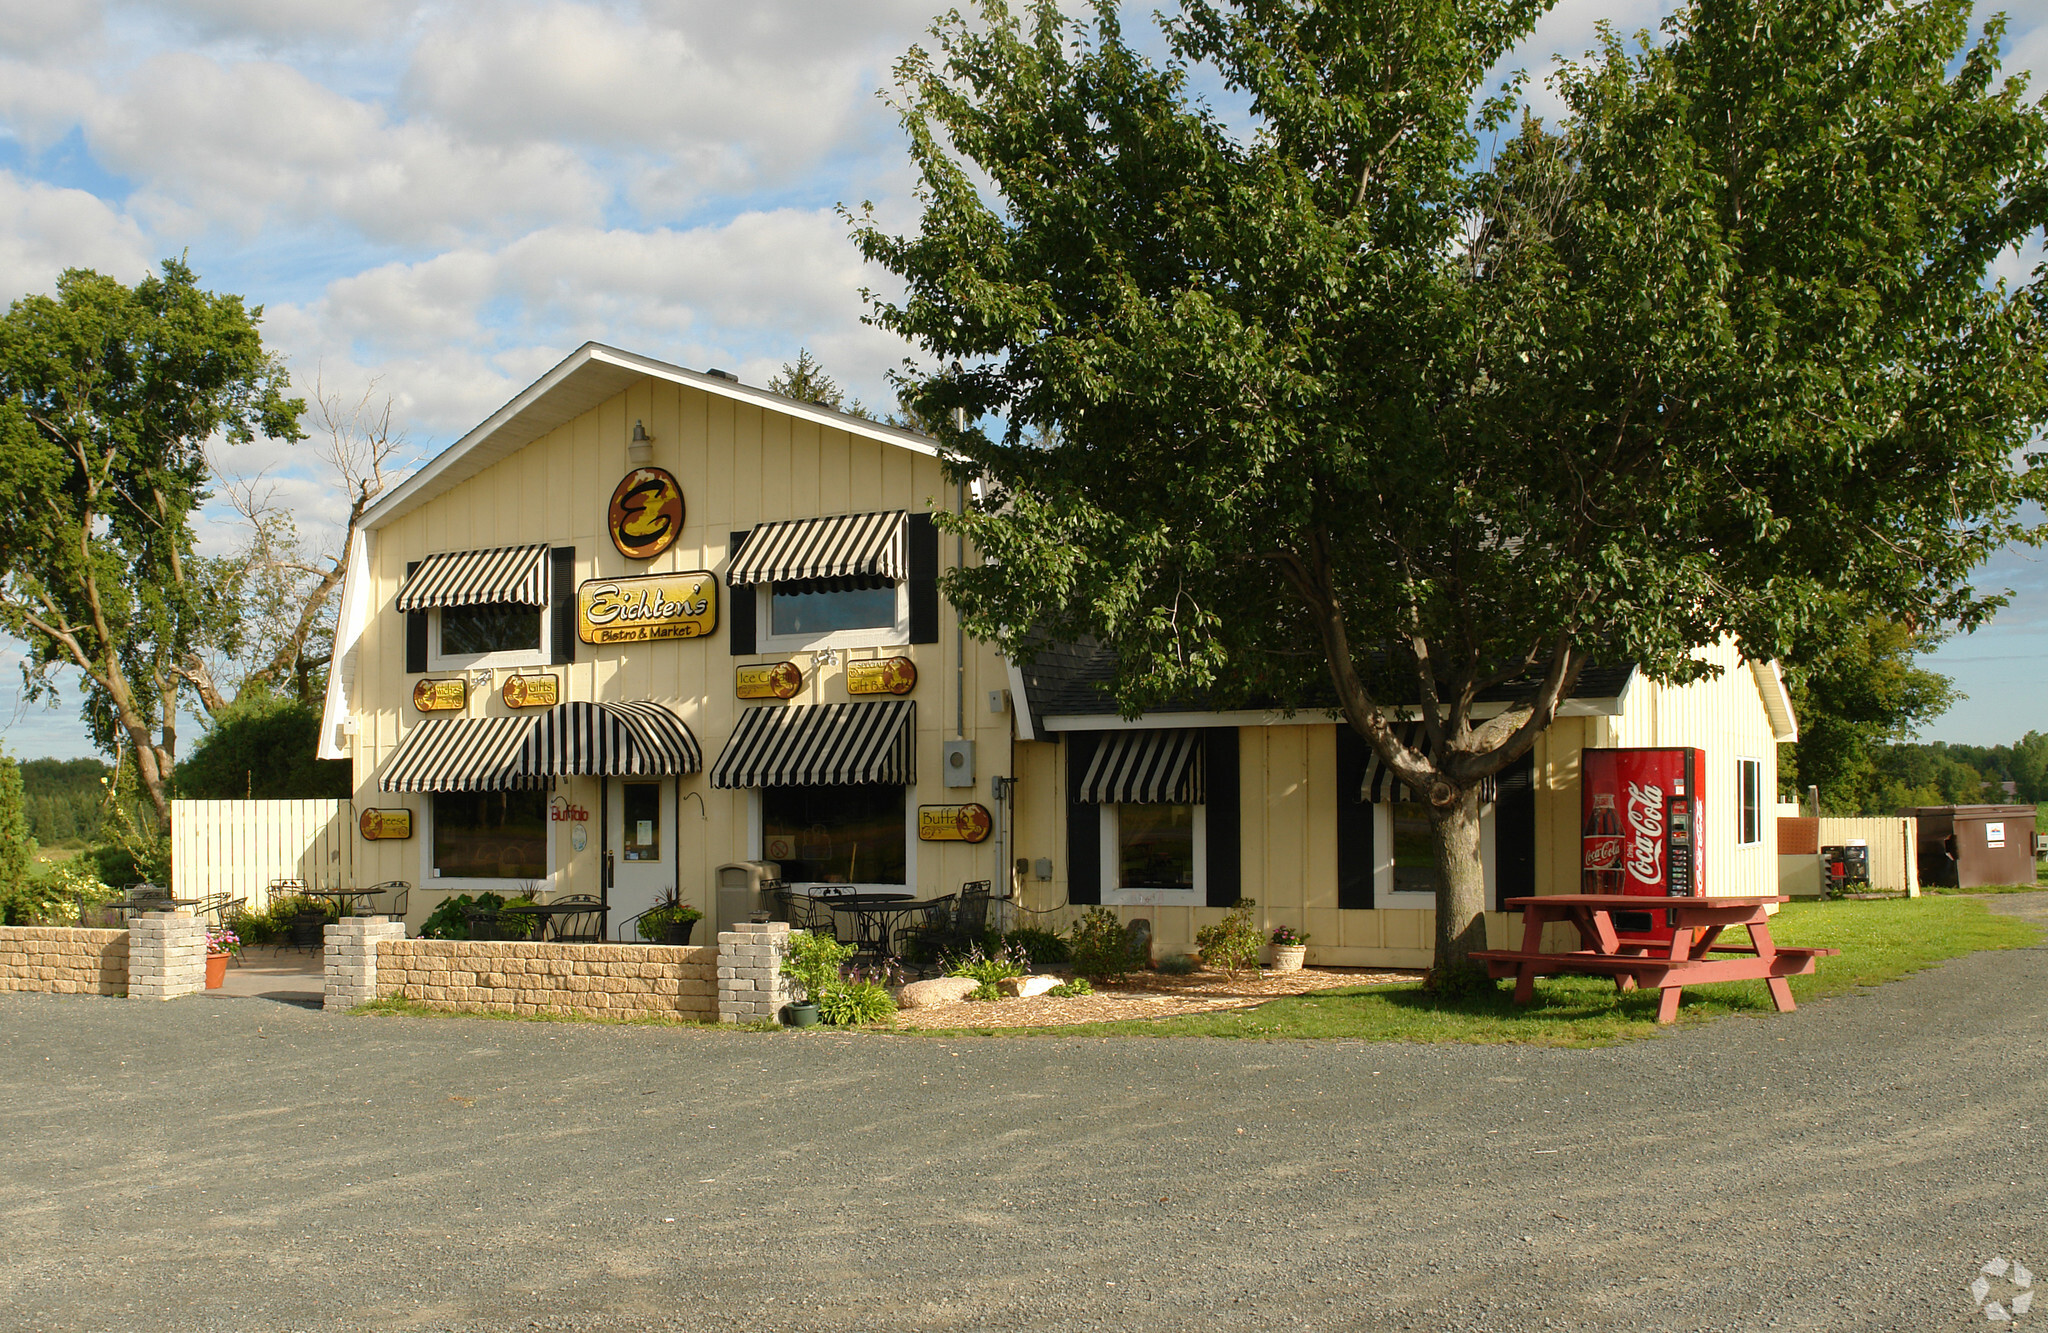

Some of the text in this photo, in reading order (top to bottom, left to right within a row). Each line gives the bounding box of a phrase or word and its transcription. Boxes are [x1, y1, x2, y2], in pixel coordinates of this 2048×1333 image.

[619, 479, 671, 548] E
[586, 583, 708, 624] Eichten's
[601, 625, 692, 642] Bistro & Market
[528, 677, 553, 693] Gifts
[739, 669, 793, 684] Ice Cram
[849, 677, 910, 692] Gift Baskts
[551, 804, 589, 821] Buffalo
[923, 807, 970, 825] Buffalo
[1627, 780, 1664, 885] Coca-Cola
[1586, 839, 1620, 866] Coca-Cola
